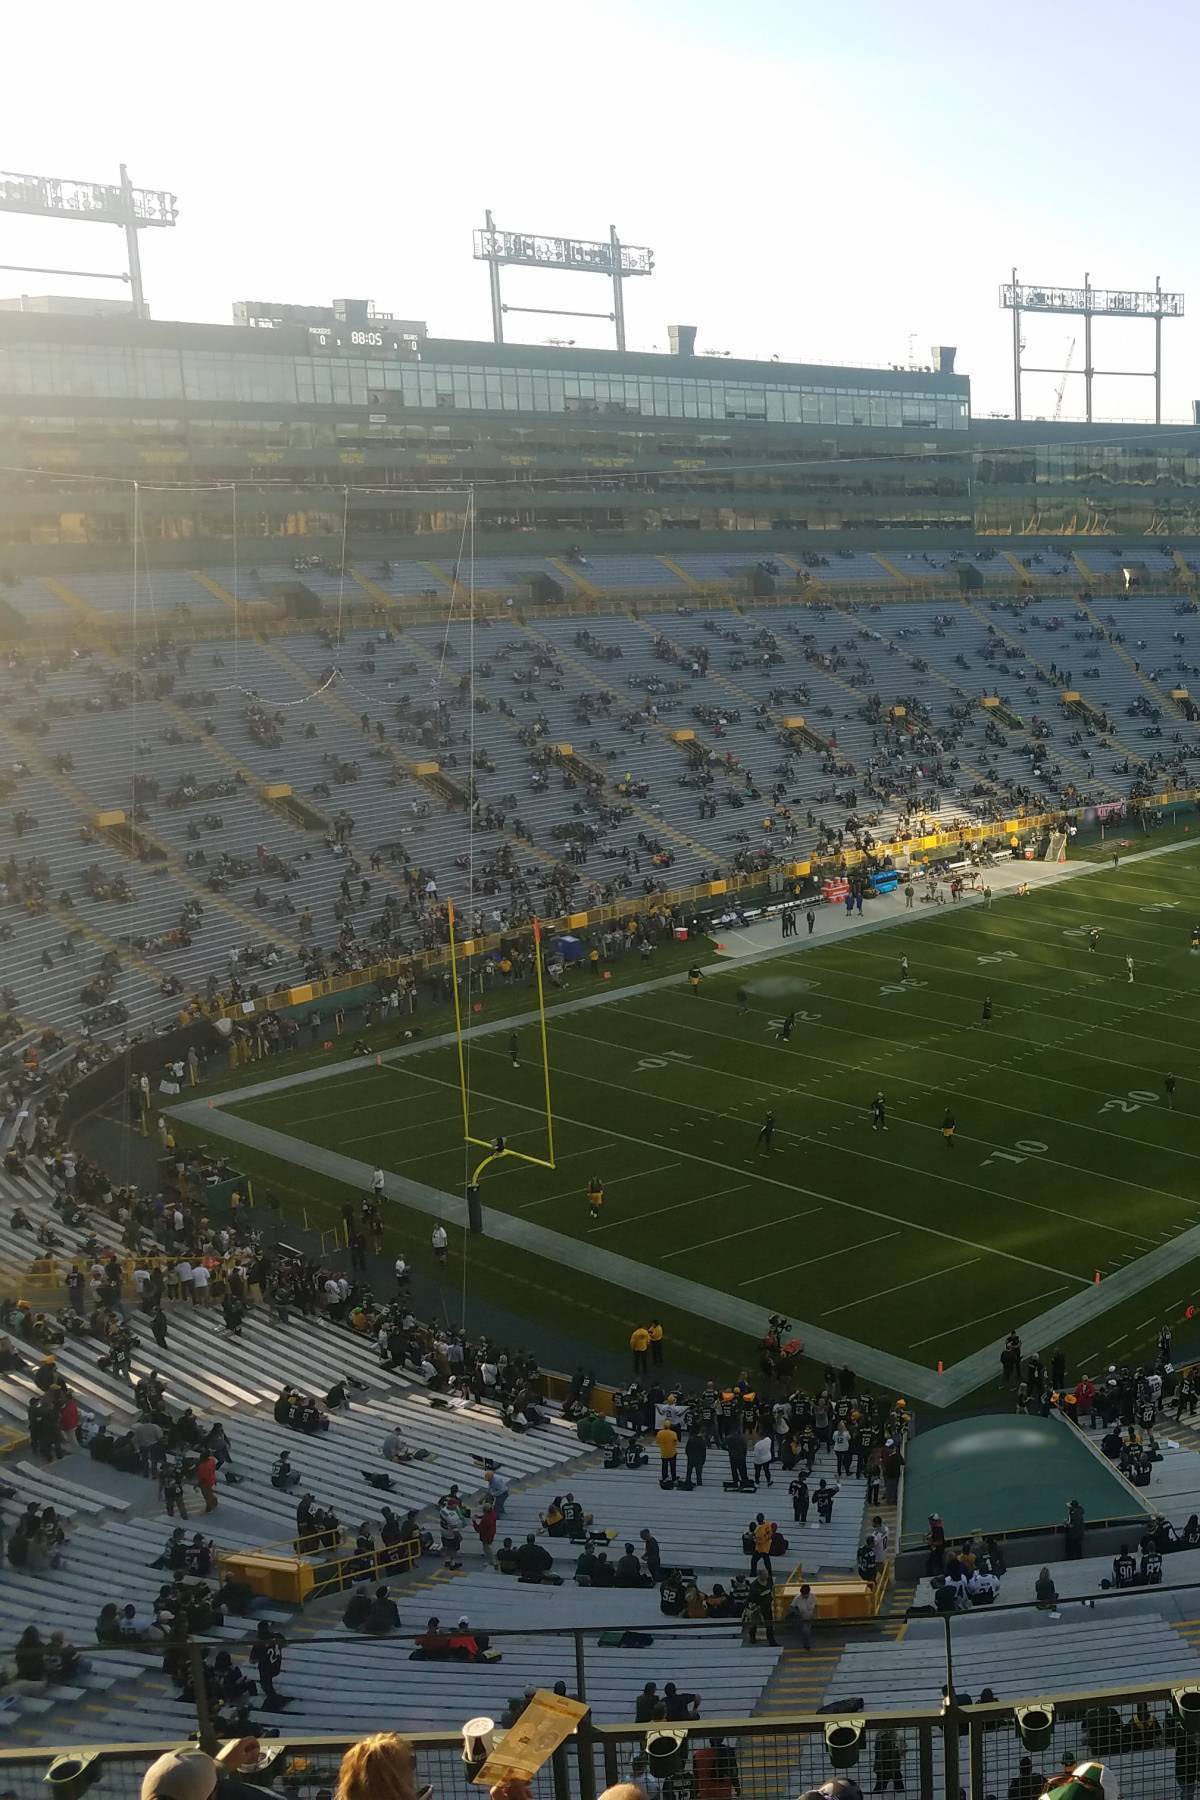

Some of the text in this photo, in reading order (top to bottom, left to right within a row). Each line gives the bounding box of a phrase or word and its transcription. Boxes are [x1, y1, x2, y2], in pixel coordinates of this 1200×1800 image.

[320, 334, 326, 345] 0
[351, 331, 383, 346] 88:05
[411, 340, 417, 351] 0
[977, 949, 1020, 966] 40
[880, 978, 930, 995] 30
[633, 1050, 695, 1071] 10
[1104, 1089, 1161, 1114] 20
[987, 1139, 1049, 1166] 10
[1153, 1382, 1161, 1392] 12
[1182, 1384, 1190, 1394] 12
[1143, 1410, 1154, 1421] 87
[862, 1437, 871, 1447] 12
[626, 1452, 636, 1464] 17
[564, 1509, 574, 1520] 12
[1120, 1565, 1133, 1579] 90
[662, 1589, 677, 1603] 52
